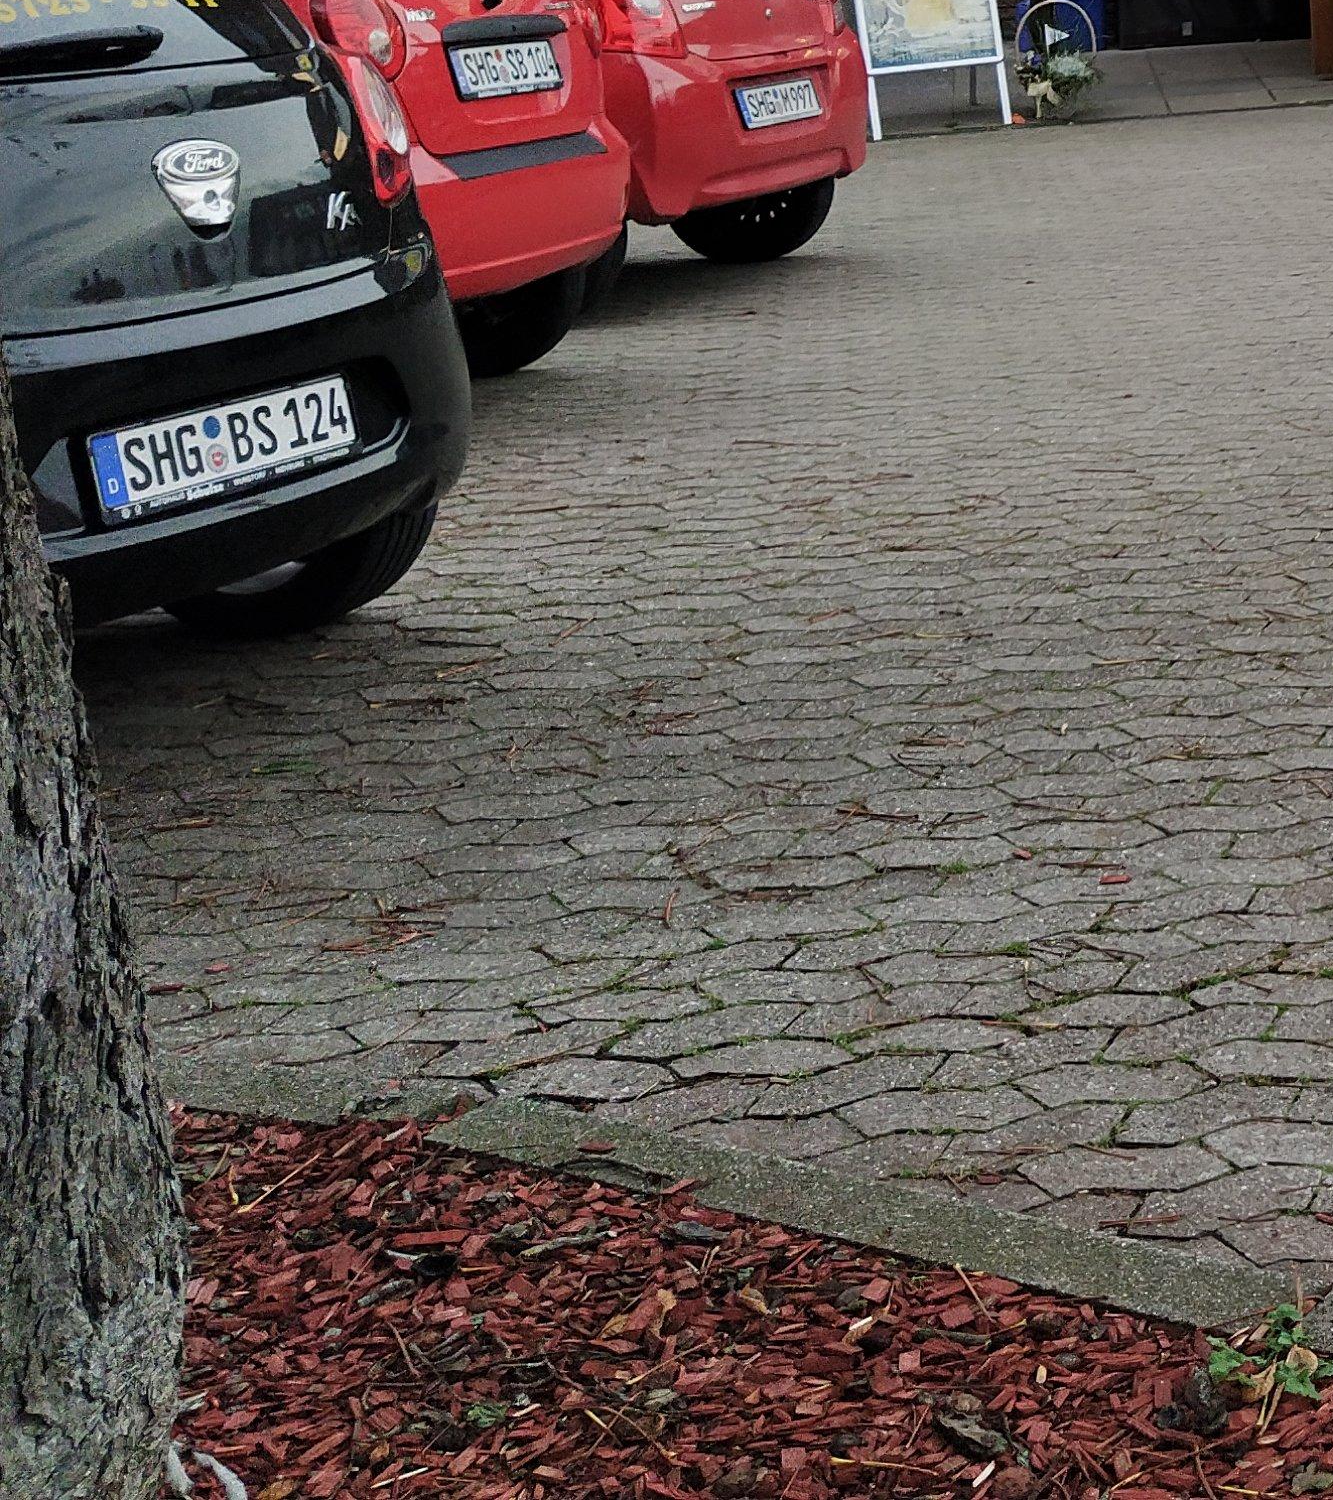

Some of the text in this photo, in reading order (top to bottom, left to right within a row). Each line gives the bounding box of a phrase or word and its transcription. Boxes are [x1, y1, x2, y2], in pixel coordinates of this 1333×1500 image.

[463, 50, 499, 86] SHG
[505, 48, 528, 80] SB
[747, 90, 776, 118] SHG
[183, 149, 225, 173] Ford
[123, 387, 348, 492] SHG BS 124
[107, 476, 120, 495] D
